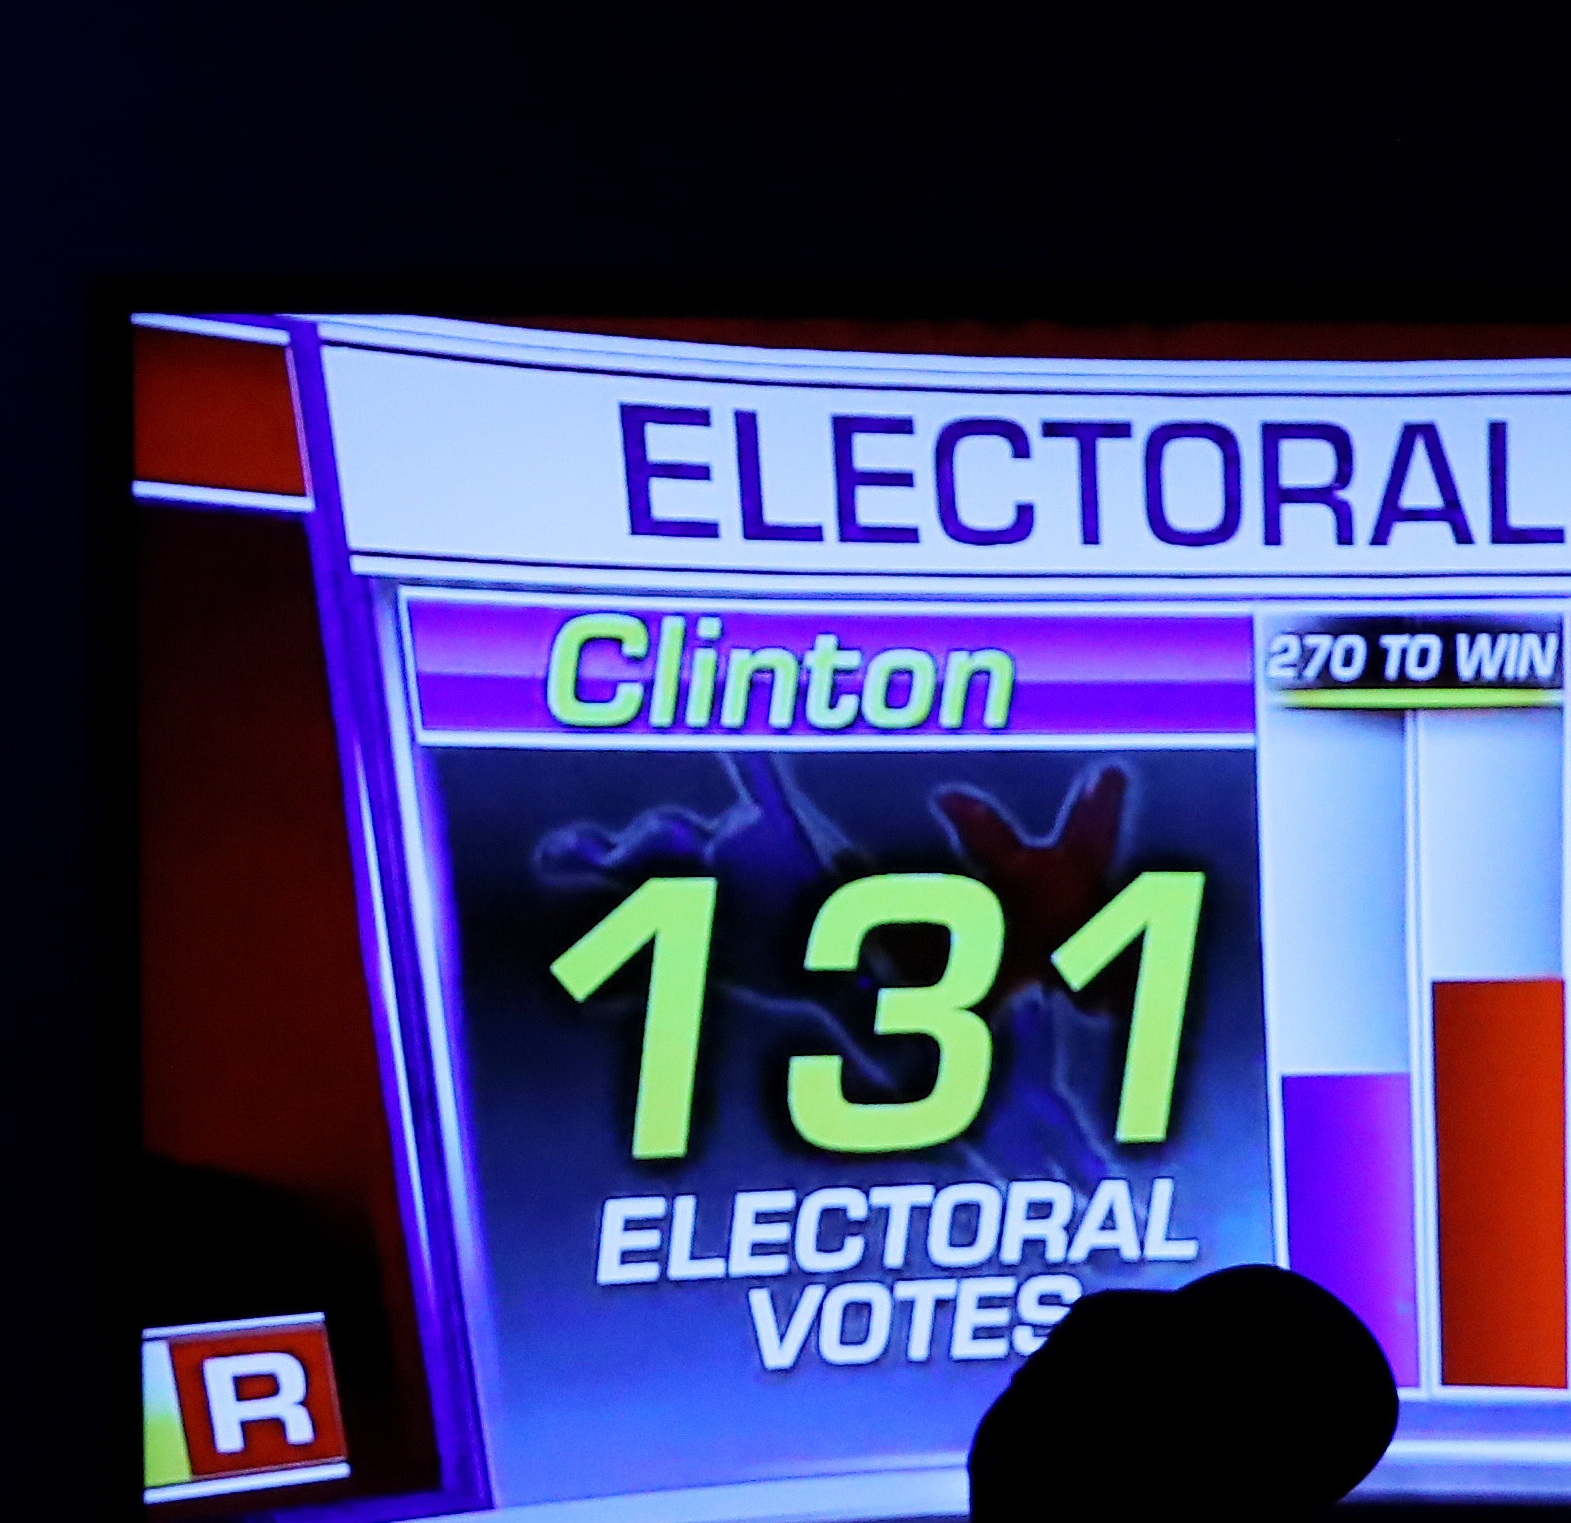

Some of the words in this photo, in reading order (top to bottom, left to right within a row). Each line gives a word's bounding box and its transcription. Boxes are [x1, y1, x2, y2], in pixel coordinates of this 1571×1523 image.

[620, 402, 1565, 546] ELECTORAL
[545, 612, 1015, 729] Clinton
[1268, 633, 1366, 682] 270
[1379, 634, 1441, 682] TO
[1455, 631, 1558, 681] WIN
[549, 871, 1206, 1159] 131
[596, 1178, 1199, 1286] ELECTORAL
[747, 1274, 1083, 1371] VOTES
[202, 1352, 315, 1455] R
